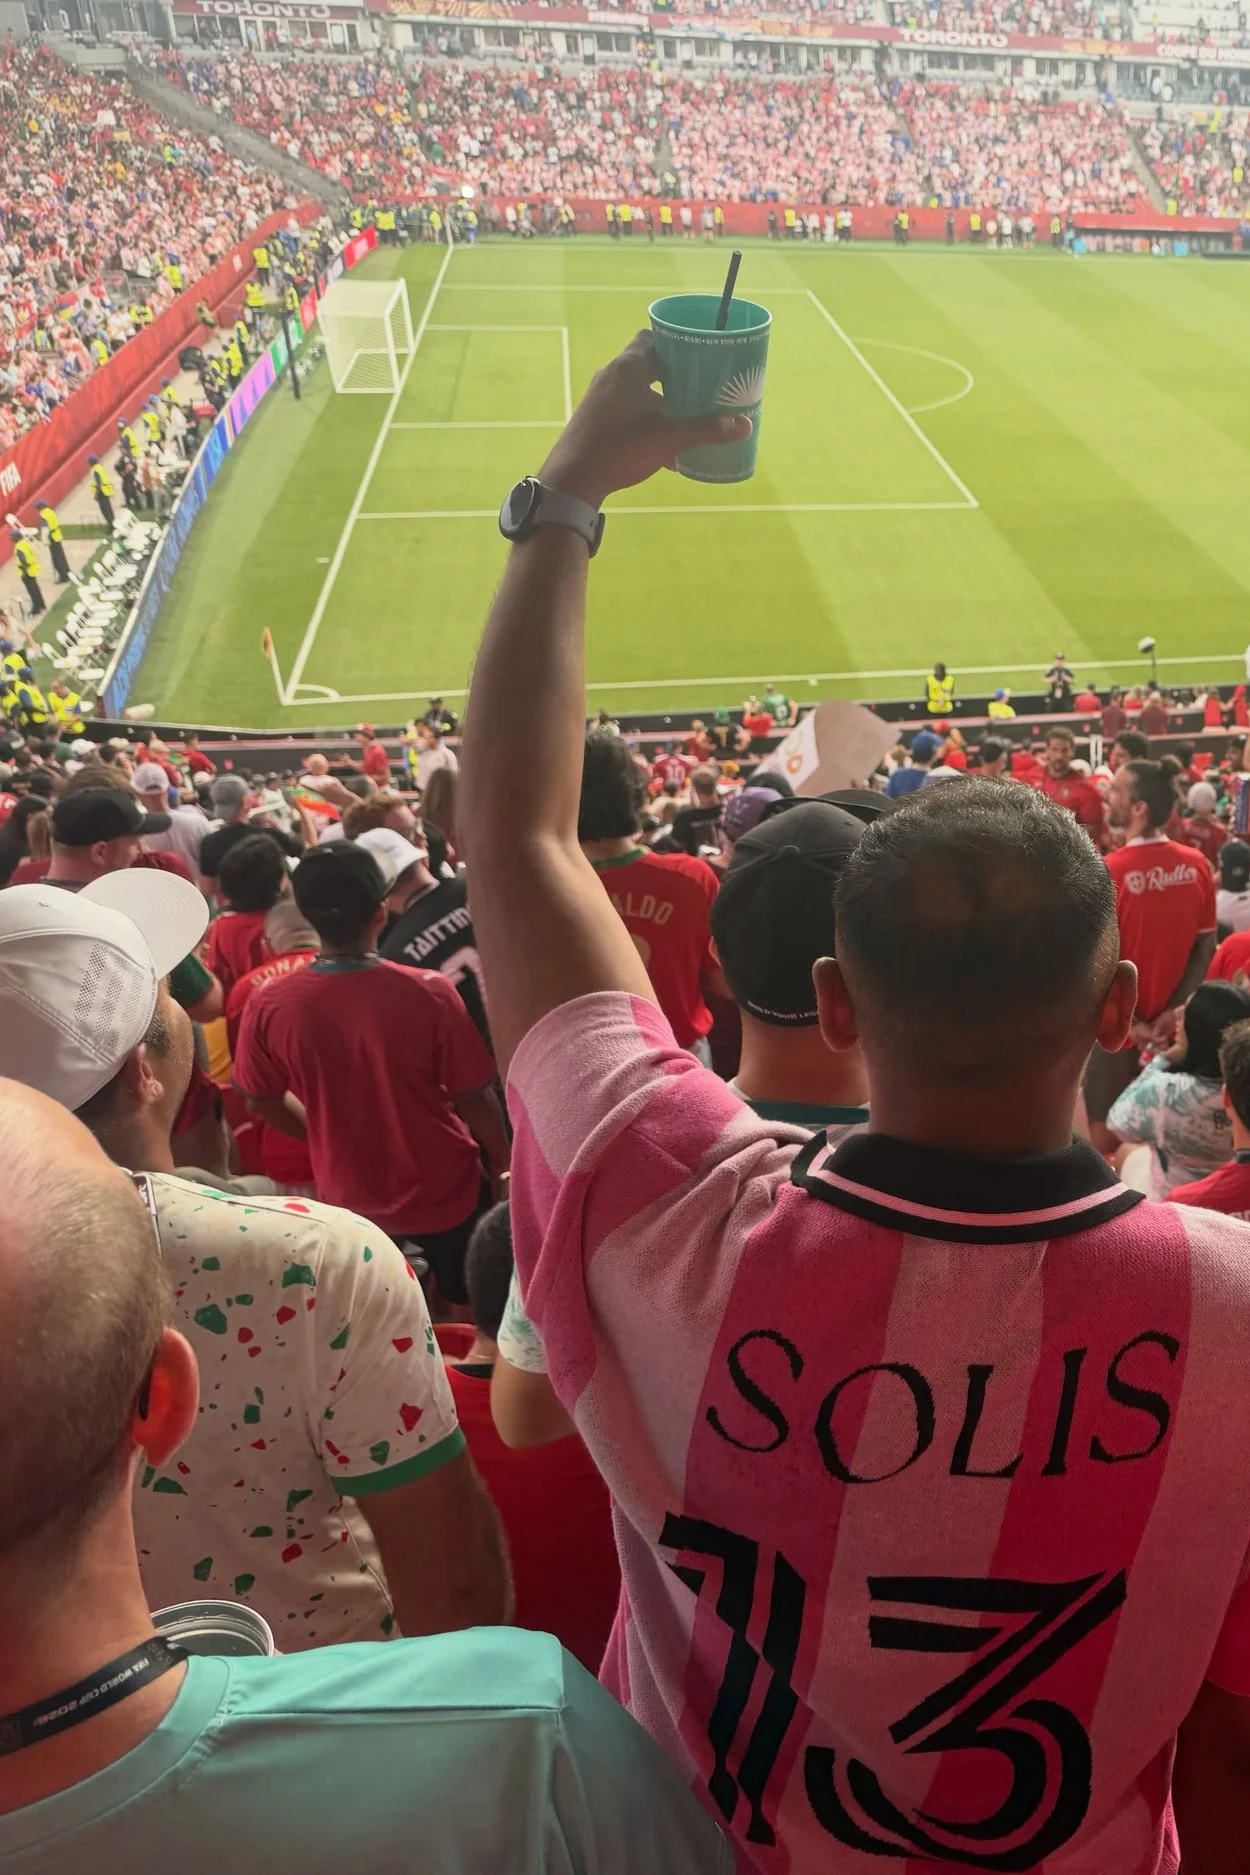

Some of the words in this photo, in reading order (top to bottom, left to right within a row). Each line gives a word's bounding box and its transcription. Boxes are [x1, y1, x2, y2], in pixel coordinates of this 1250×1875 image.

[197, 0, 332, 18] TORONTO
[901, 30, 1008, 48] TORONTO
[706, 1328, 1181, 1485] SOLIS
[132, 1657, 150, 1674] FIFA
[99, 1665, 134, 1693] WORLD
[78, 1689, 101, 1708] CUP
[657, 1511, 1128, 1872] 13
